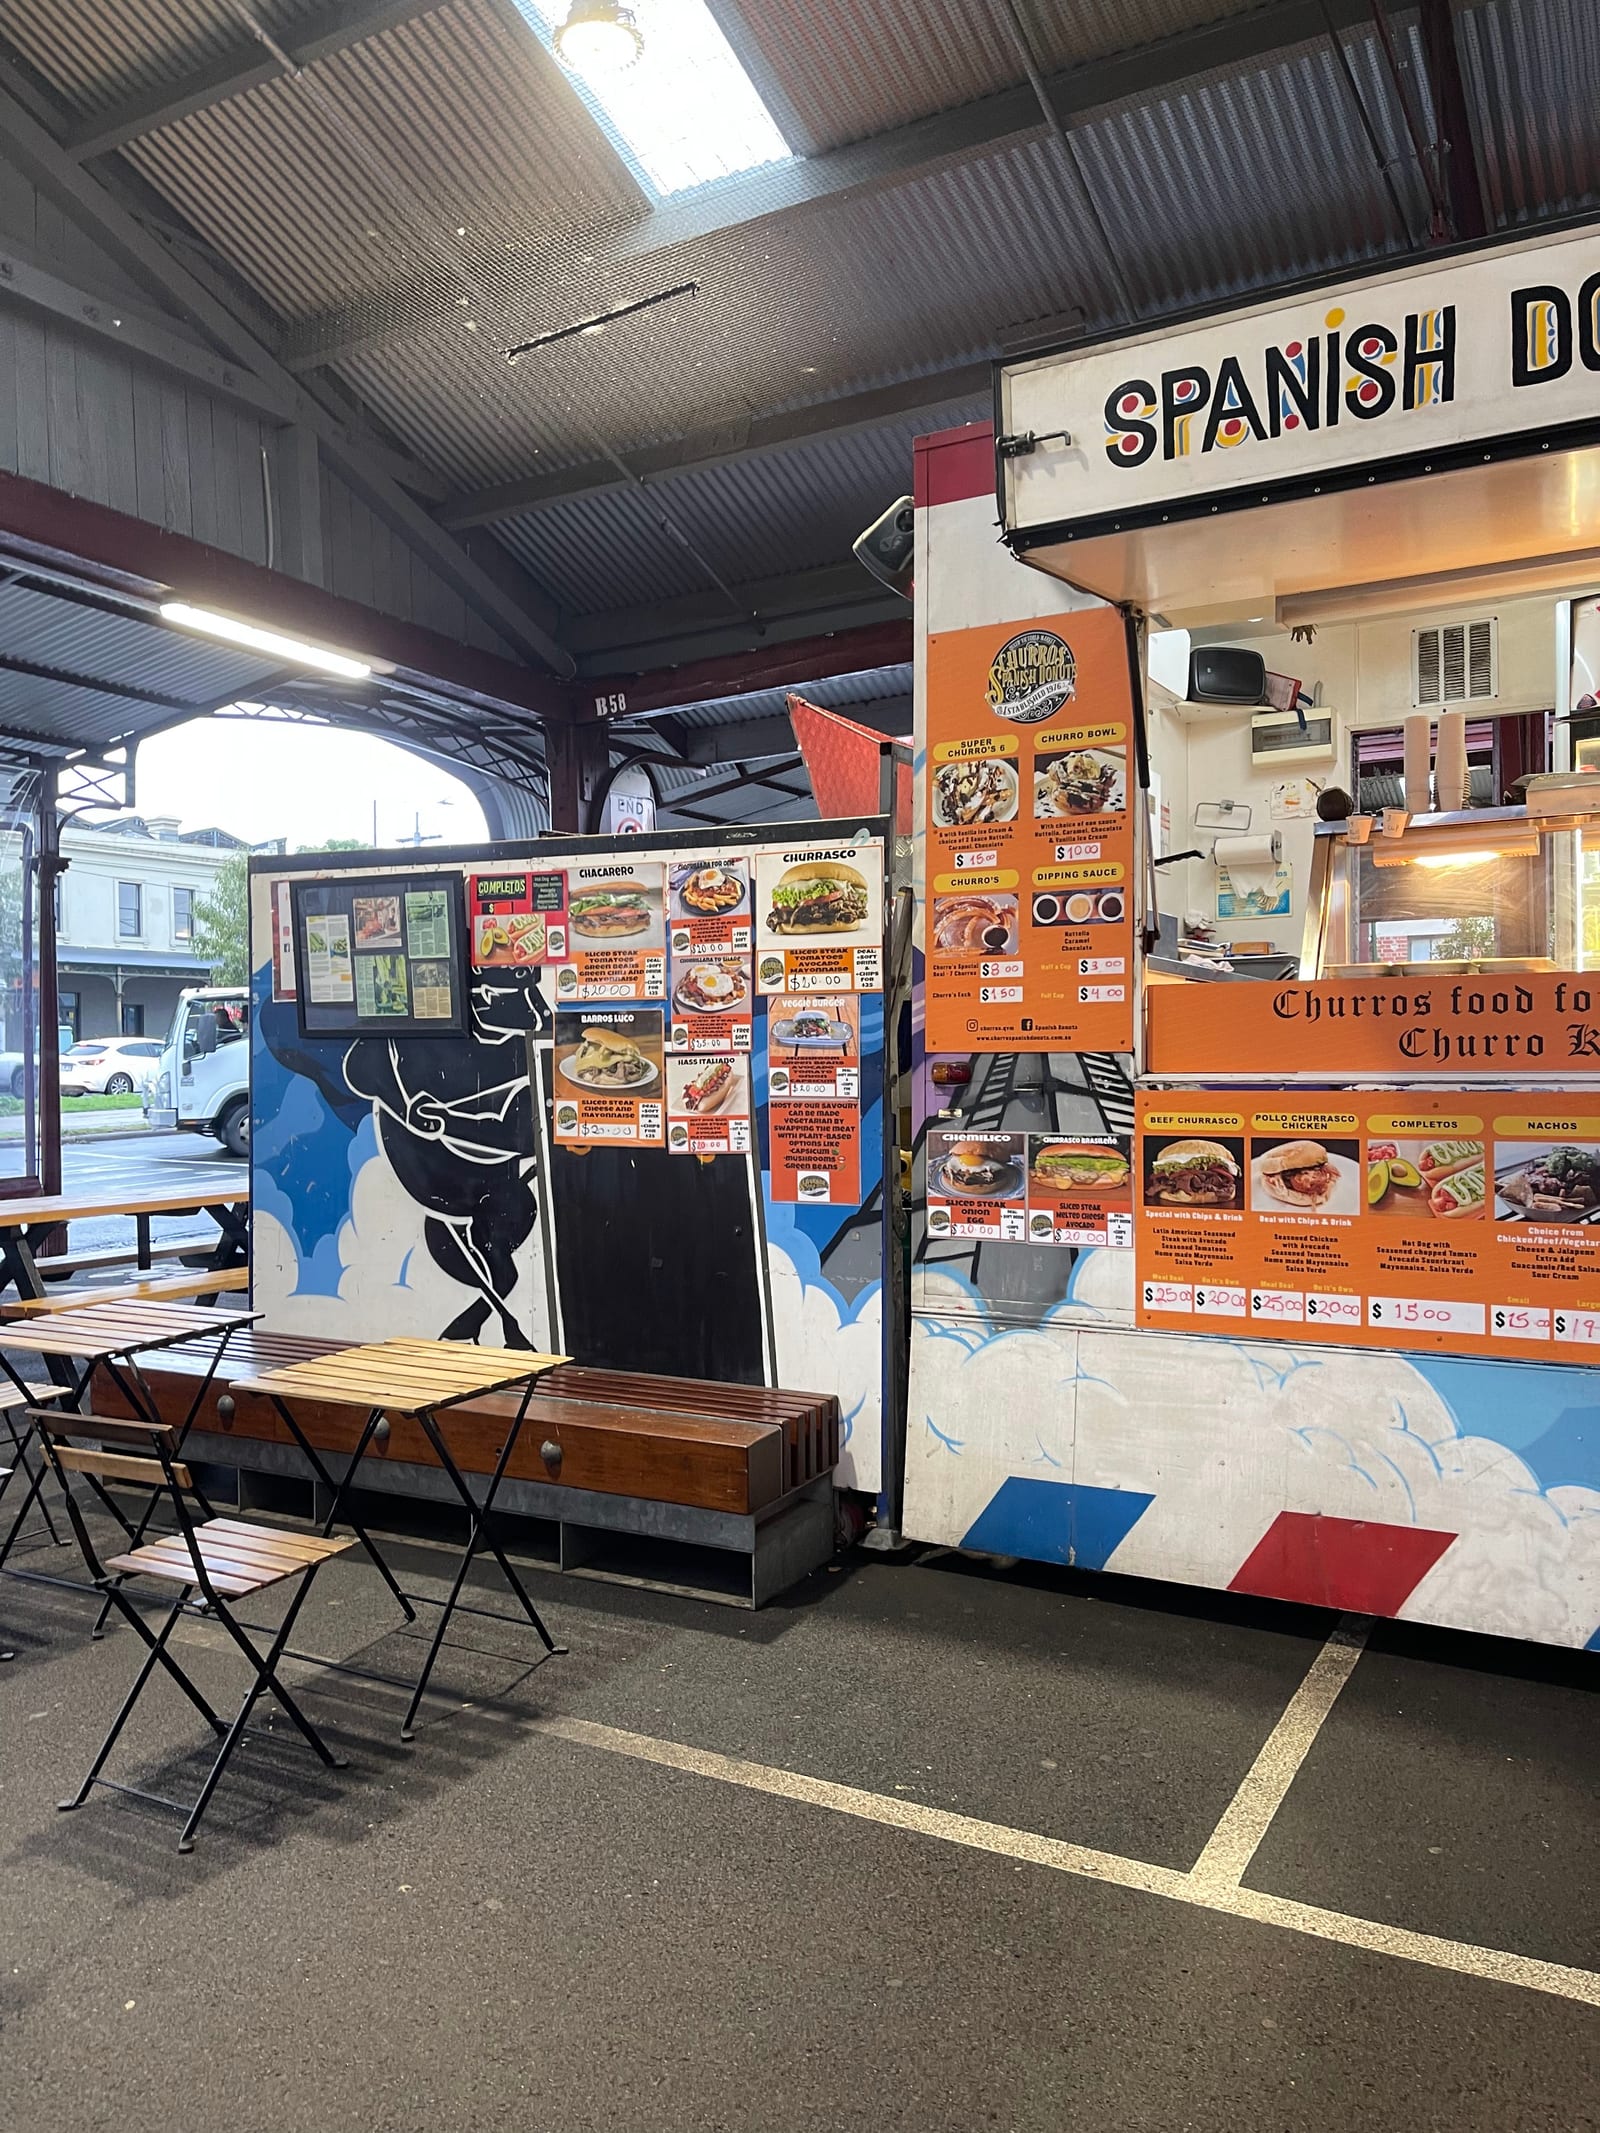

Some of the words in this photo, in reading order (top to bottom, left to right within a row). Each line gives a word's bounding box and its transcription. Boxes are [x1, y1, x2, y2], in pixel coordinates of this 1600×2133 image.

[1104, 304, 1456, 468] SPANISH
[998, 644, 1066, 672] CHURROS
[986, 665, 1037, 705] SPANISH
[1039, 663, 1078, 685] DONUTS
[1003, 690, 1047, 715] ESTABLISHED
[1046, 682, 1061, 693] 1976
[1041, 731, 1085, 744] CHURRO
[1087, 727, 1117, 739] BOWL
[960, 738, 993, 749] SUPER
[947, 745, 996, 758] CHURRO'S
[999, 744, 1006, 752] 6
[617, 798, 644, 815] END
[783, 849, 857, 863] CHURRASCO
[579, 866, 634, 879] CHACARERO
[1037, 870, 1080, 881] DIPPING
[1083, 868, 1118, 879] SAUCE
[478, 879, 526, 894] COMPLETOS
[950, 876, 1000, 887] CHURRO'S
[585, 975, 639, 983] MAYONNAISE
[782, 999, 811, 1008] VEGGIE
[812, 999, 845, 1008] BURGER
[1272, 989, 1432, 1024] Churros
[1450, 985, 1534, 1017] food
[1554, 982, 1600, 1014] fo
[581, 1014, 614, 1024] BARROS
[614, 1014, 635, 1023] LUCO
[1398, 1027, 1545, 1064] Churro
[1150, 1116, 1174, 1124] BEEF
[1177, 1116, 1239, 1125] CHURRASCO
[1255, 1114, 1288, 1122] POLLO
[1291, 1114, 1355, 1123] CHURRASCO
[1281, 1122, 1328, 1130] CHICKEN
[1391, 1120, 1458, 1129] COMPLETOS
[1527, 1121, 1577, 1130] NACHOS
[942, 1134, 1012, 1143] CHEMILICO
[977, 1200, 1006, 1209] STEAK
[1059, 1202, 1080, 1210] SLICED
[961, 1208, 991, 1216] ONION
[1055, 1211, 1081, 1219] MELTED
[1081, 1212, 1105, 1220] CHEESE
[1145, 1210, 1173, 1218] Special
[1192, 1212, 1213, 1221] Chips
[1223, 1213, 1243, 1221] Drink
[1065, 1221, 1095, 1229] AVOCADO
[1259, 1215, 1277, 1223] Deal
[1278, 1216, 1296, 1224] with
[1297, 1216, 1320, 1226] Chips
[1321, 1218, 1329, 1226] &
[1330, 1218, 1352, 1227] Drink
[1203, 1230, 1236, 1238] Seasoned
[1528, 1227, 1559, 1236] Choice
[1562, 1228, 1584, 1237] from
[1198, 1237, 1227, 1245] Avocado
[1274, 1233, 1308, 1242] Seasoned
[1309, 1235, 1339, 1243] Chicken
[1161, 1242, 1193, 1251] Seasoned
[1194, 1244, 1227, 1252] Tomatoes
[1416, 1240, 1431, 1249] Dog
[1433, 1241, 1451, 1249] with
[1515, 1245, 1546, 1253] Cheese
[1193, 1252, 1234, 1261] Mayonnaise
[1271, 1249, 1305, 1257] Seasoned
[1307, 1251, 1341, 1259] Tomatoes
[1376, 1246, 1412, 1254] Seasoned
[1414, 1248, 1447, 1257] chopped
[1448, 1250, 1477, 1258] Tomato
[1174, 1258, 1193, 1266] Salsa
[1194, 1259, 1213, 1267] Verde
[1305, 1258, 1349, 1268] Mayonnaise
[1388, 1255, 1420, 1263] Avocado
[1421, 1257, 1465, 1266] Sauerkraut
[1535, 1254, 1558, 1262] Extra
[1560, 1255, 1575, 1263] Add
[1285, 1265, 1305, 1273] Salsa
[1306, 1266, 1327, 1274] Verde
[1429, 1265, 1450, 1273] Salsa
[1451, 1266, 1474, 1274] Verde
[1552, 1272, 1580, 1280] Cream
